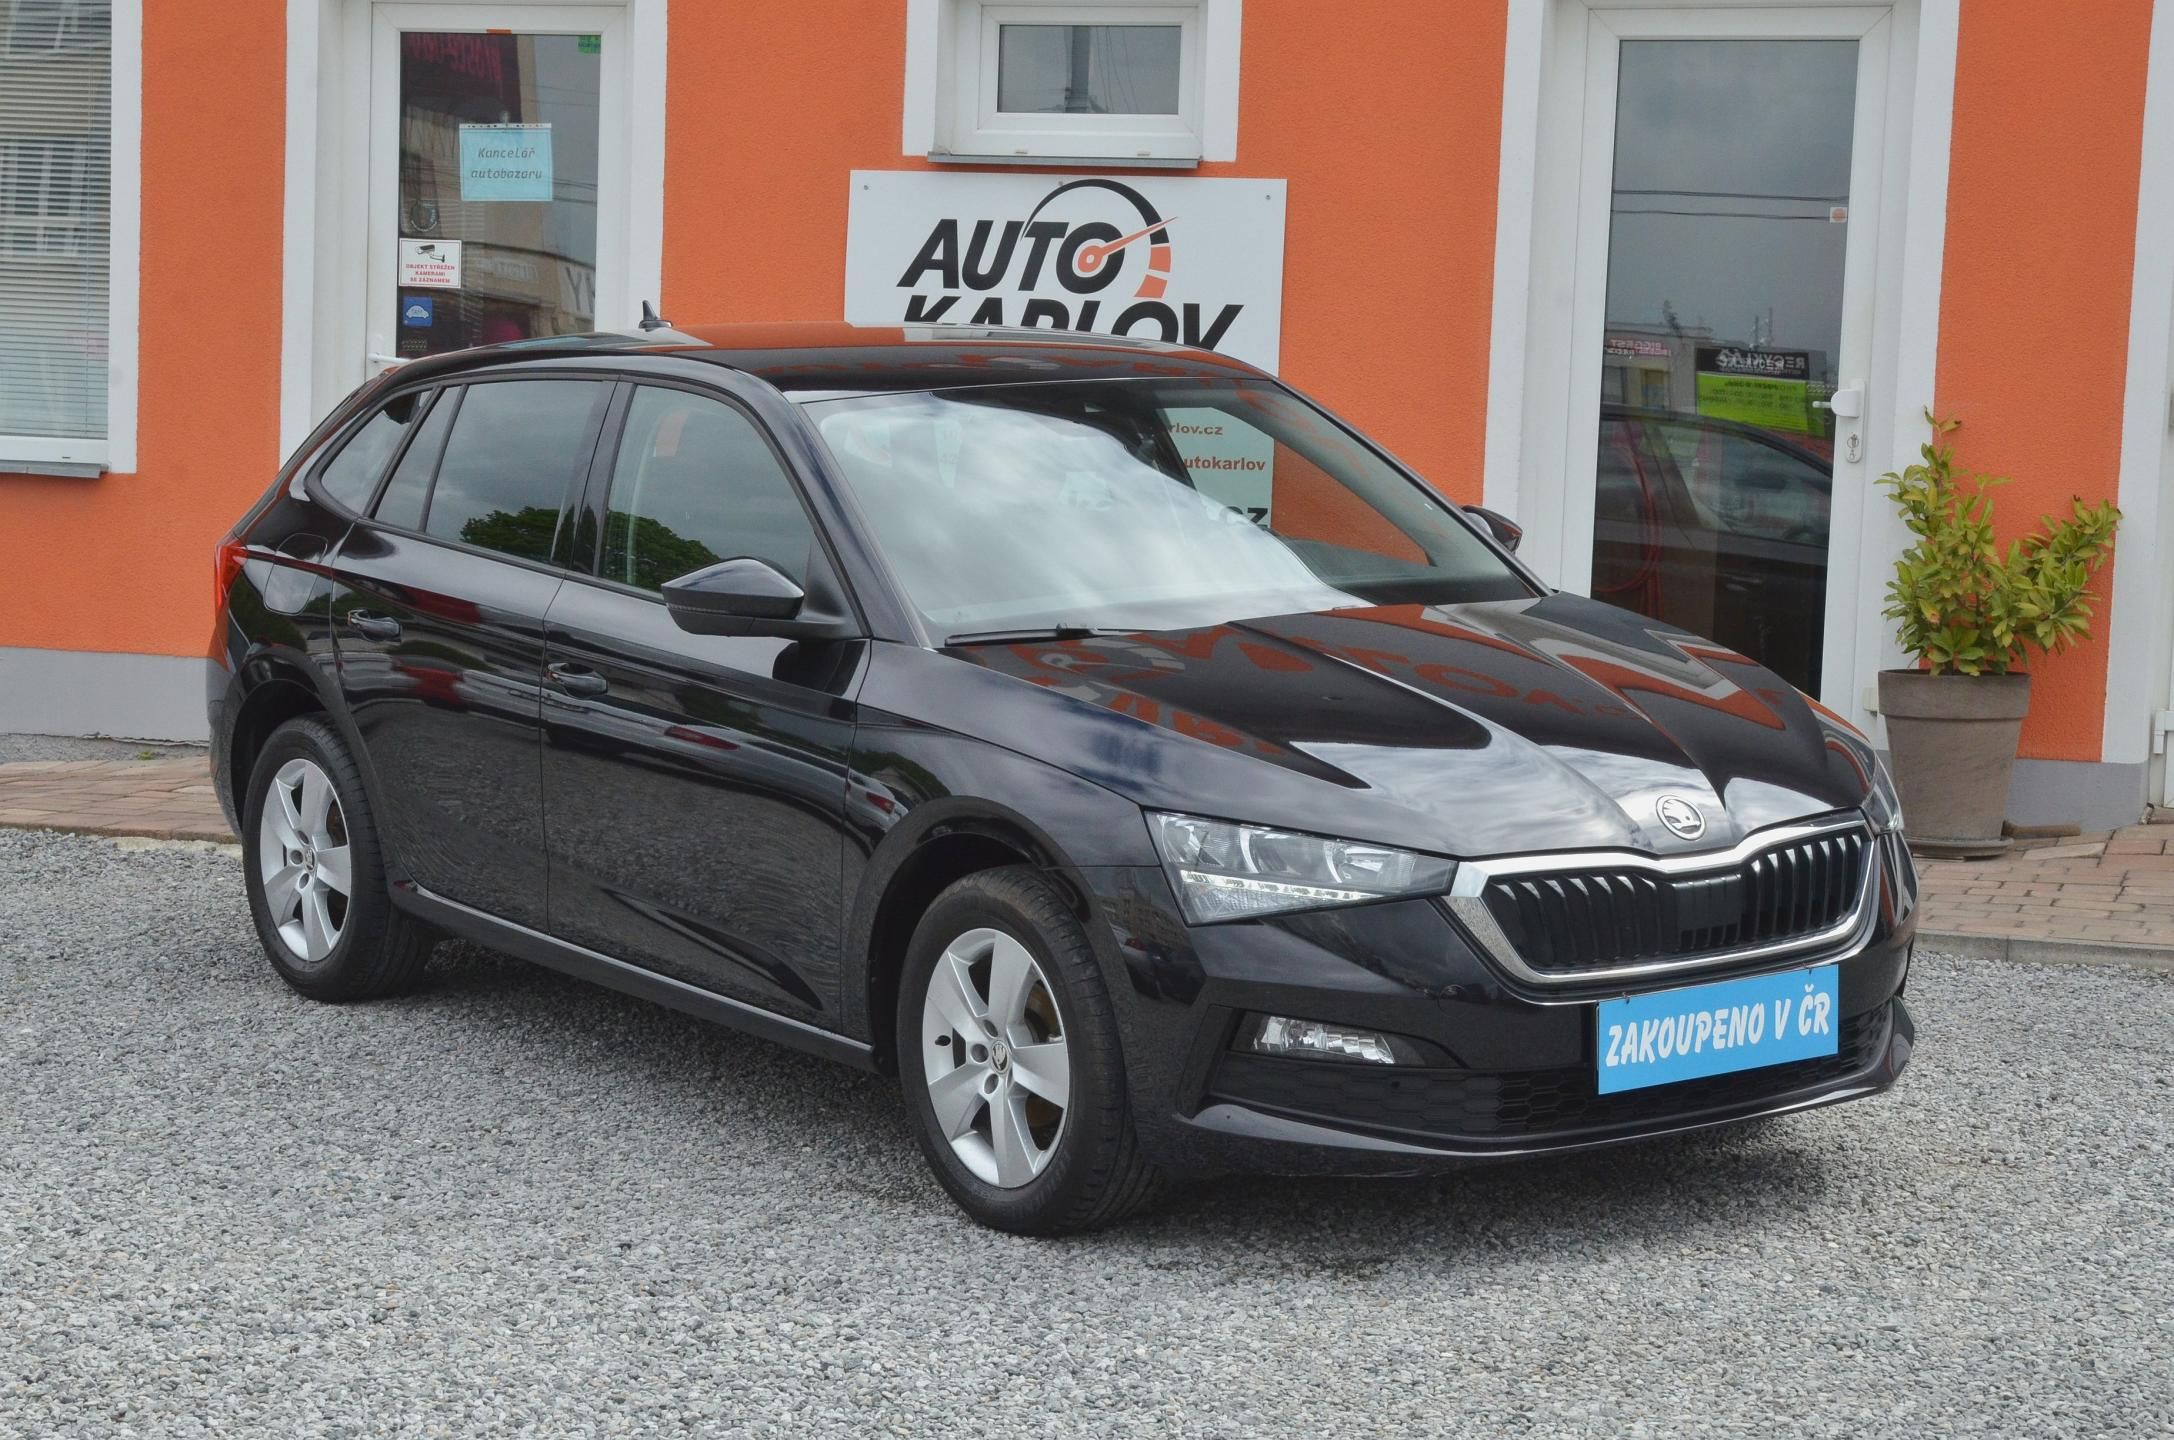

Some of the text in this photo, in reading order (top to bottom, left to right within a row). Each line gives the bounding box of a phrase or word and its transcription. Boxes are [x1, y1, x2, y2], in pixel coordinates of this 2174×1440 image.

[478, 146, 536, 159] Kancelář
[471, 168, 542, 180] autobazaru
[896, 218, 1126, 294] AUTO
[1183, 456, 1266, 471] utokarlov
[1606, 984, 1831, 1067] ZAKOUPENO V ČR
